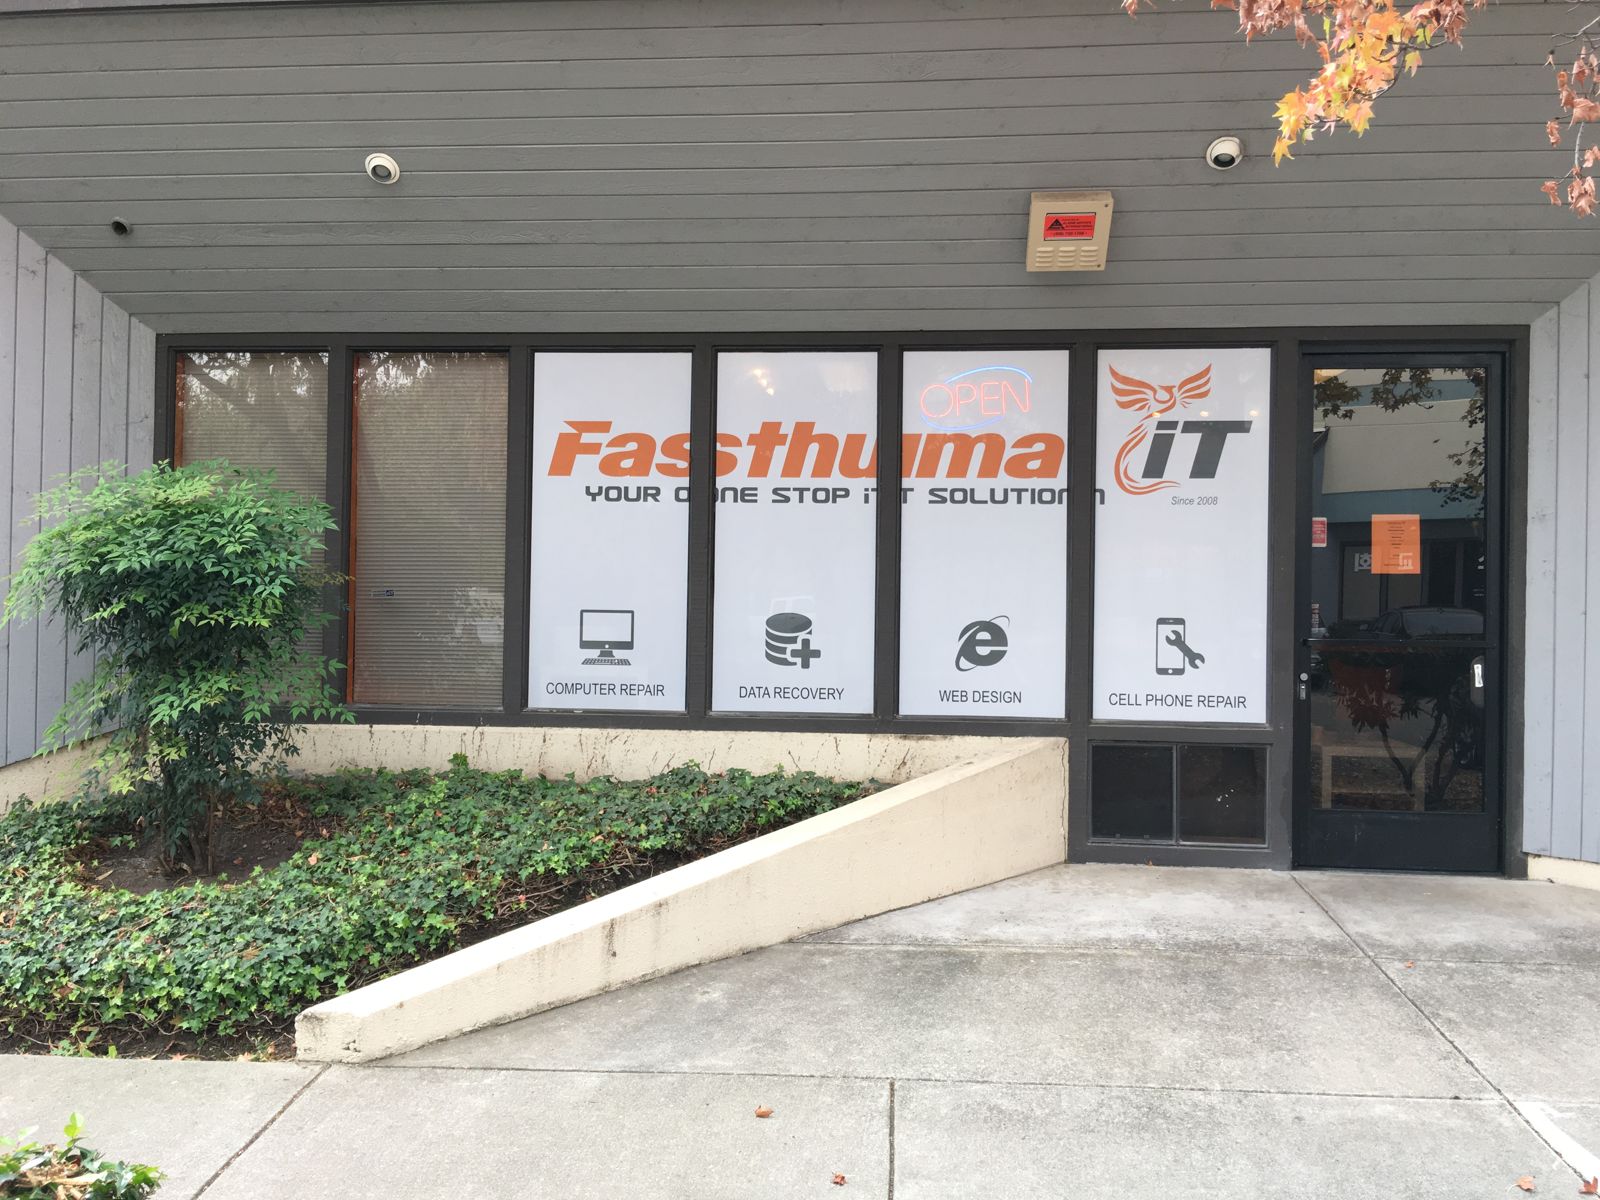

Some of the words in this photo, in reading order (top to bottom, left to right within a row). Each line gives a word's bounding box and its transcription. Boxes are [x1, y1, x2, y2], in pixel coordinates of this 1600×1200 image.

[920, 379, 1032, 418] OPEN
[585, 485, 661, 503] YOUR
[771, 487, 850, 504] STOP
[1171, 496, 1195, 506] Since
[1197, 496, 1218, 506] 2008
[546, 682, 617, 696] COMPUTER
[619, 683, 665, 697] REPAIR
[739, 686, 771, 699] DATA
[773, 686, 845, 700] RECOVERY
[938, 689, 969, 703] WEB
[972, 690, 1022, 704] DESIGN
[1108, 692, 1142, 706] CELL
[1145, 693, 1193, 708] PHONE
[1197, 695, 1247, 709] REPAIR
